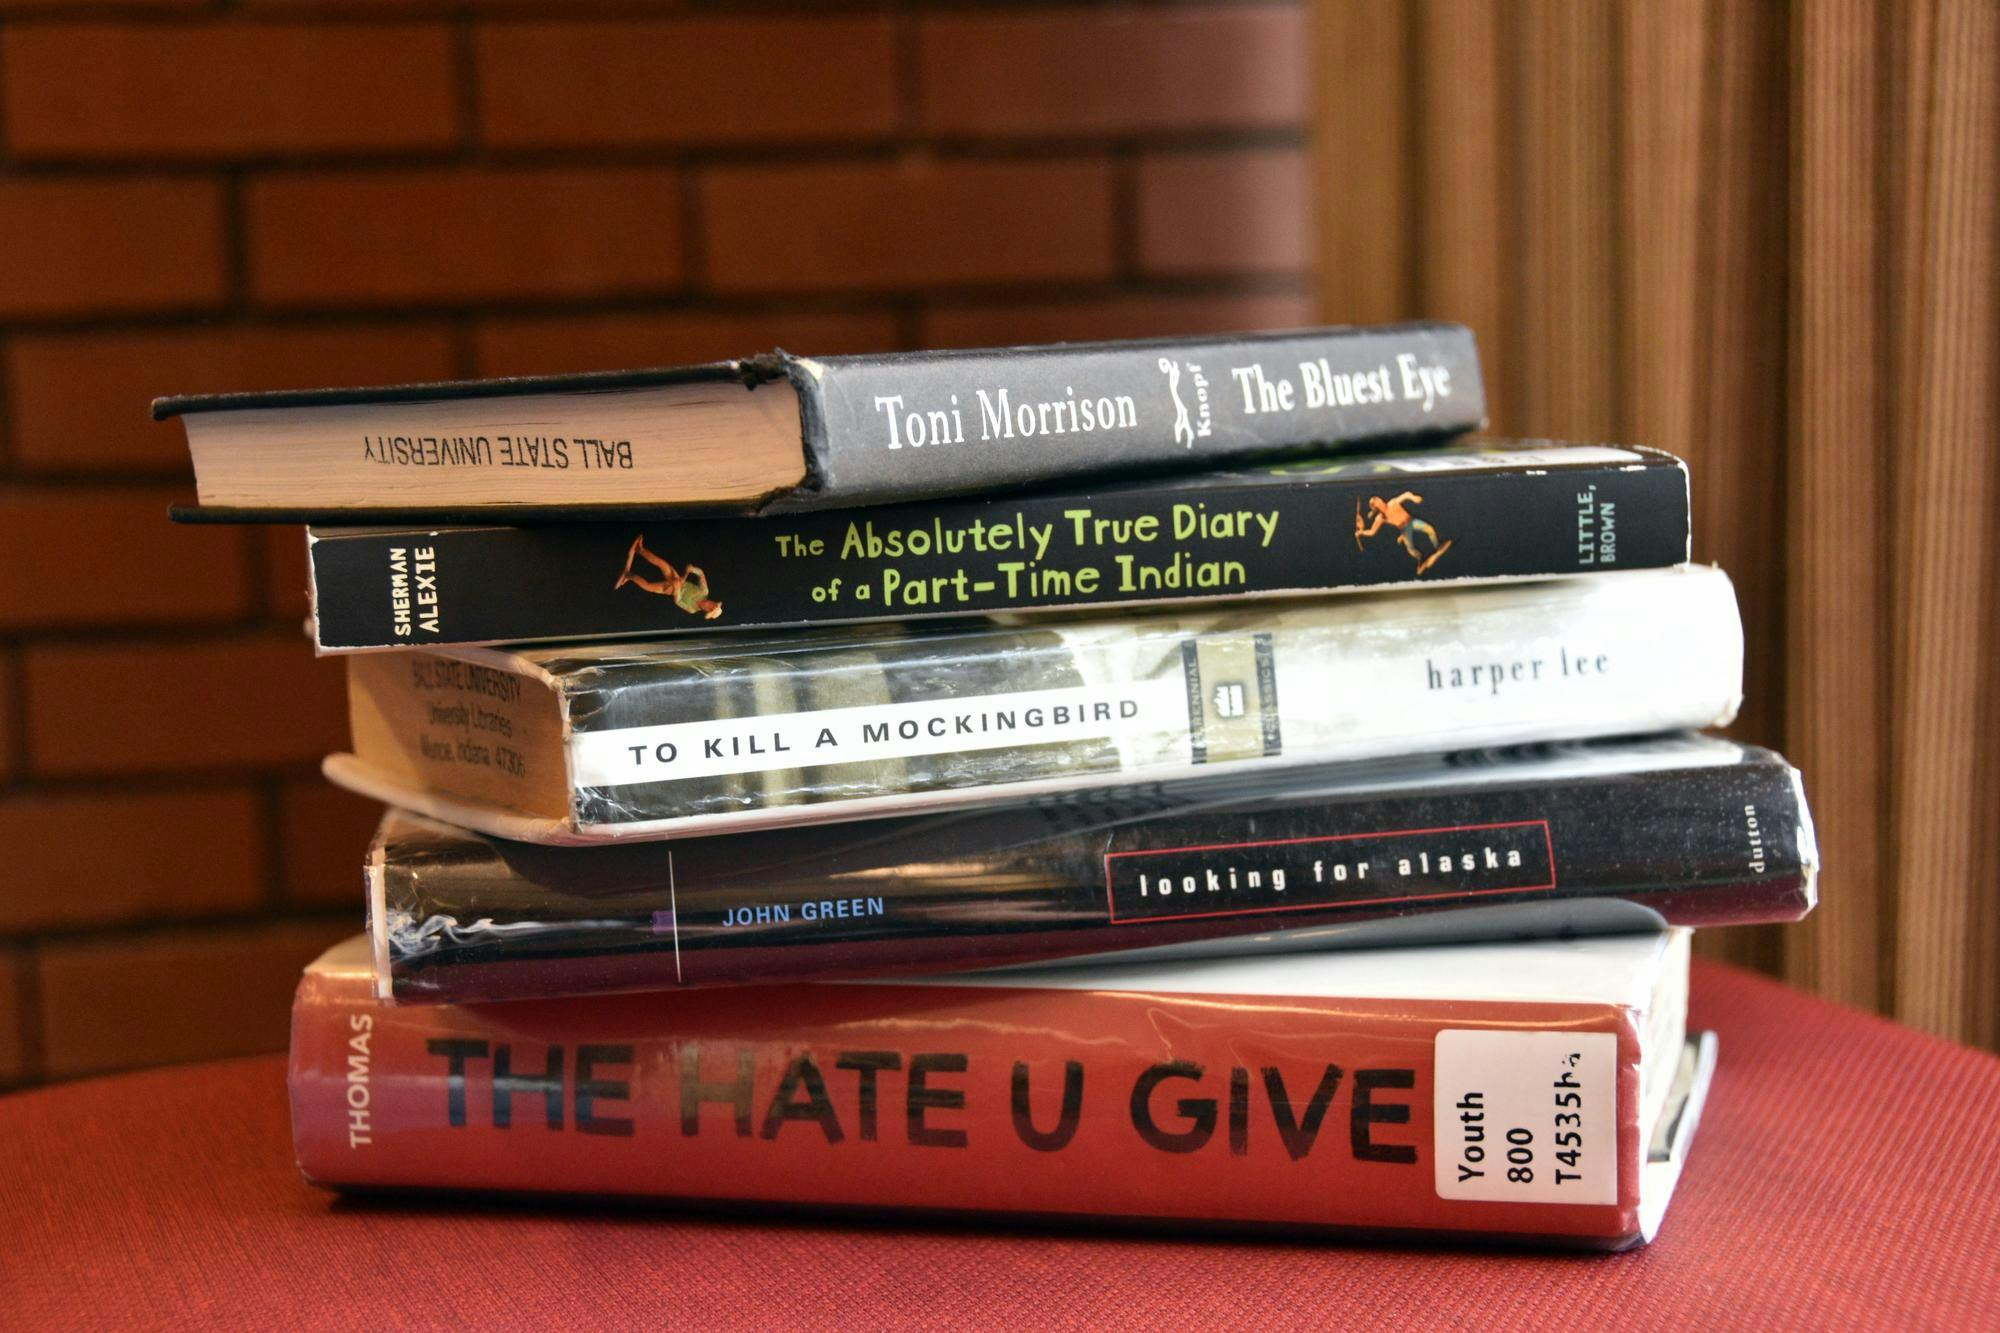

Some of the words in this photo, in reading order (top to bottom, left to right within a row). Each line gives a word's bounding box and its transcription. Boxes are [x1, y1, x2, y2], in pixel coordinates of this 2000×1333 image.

[1186, 362, 1212, 437] Knopf
[1232, 363, 1295, 415] The
[1304, 357, 1395, 410] Bluest
[1397, 353, 1453, 413] Eye
[874, 393, 964, 450] Toni
[976, 386, 1138, 441] Morrison
[364, 436, 493, 466] UNIVERSITY
[497, 437, 569, 469] STATE
[573, 439, 633, 469] BALL
[775, 535, 825, 558] The
[840, 513, 1053, 561] Absolutely
[1064, 509, 1159, 547] True
[1172, 503, 1279, 548] Diary
[1577, 484, 1597, 565] LITTLE,
[1600, 502, 1616, 563] BROWN
[389, 547, 412, 636] SHERMAN
[414, 546, 440, 633] ALEXIE
[811, 578, 842, 603] of
[855, 582, 871, 601] a
[883, 560, 1100, 607] Part-Time
[1114, 552, 1247, 593] Indian
[465, 661, 522, 705] UNIVERSITY
[1426, 659, 1544, 696] harper
[1561, 646, 1608, 677] lee
[628, 742, 678, 767] TO
[704, 732, 791, 759] KILL
[814, 727, 839, 749] A
[862, 699, 1139, 745] MOCKINGBIRD
[1188, 659, 1206, 746] RENNIAL
[1744, 805, 1765, 873] dutton
[1139, 866, 1287, 897] looking
[1313, 859, 1370, 883] for
[1398, 847, 1522, 877] alaska
[722, 902, 791, 928] JOHN
[801, 897, 885, 923] GREEN
[349, 1013, 373, 1149] THOMAS
[427, 1039, 635, 1138] THE
[679, 1044, 968, 1149] HATE
[1010, 1060, 1085, 1152] U
[1129, 1060, 1418, 1165] GIVE
[1456, 1092, 1485, 1183] Youth
[1506, 1127, 1534, 1184] 800
